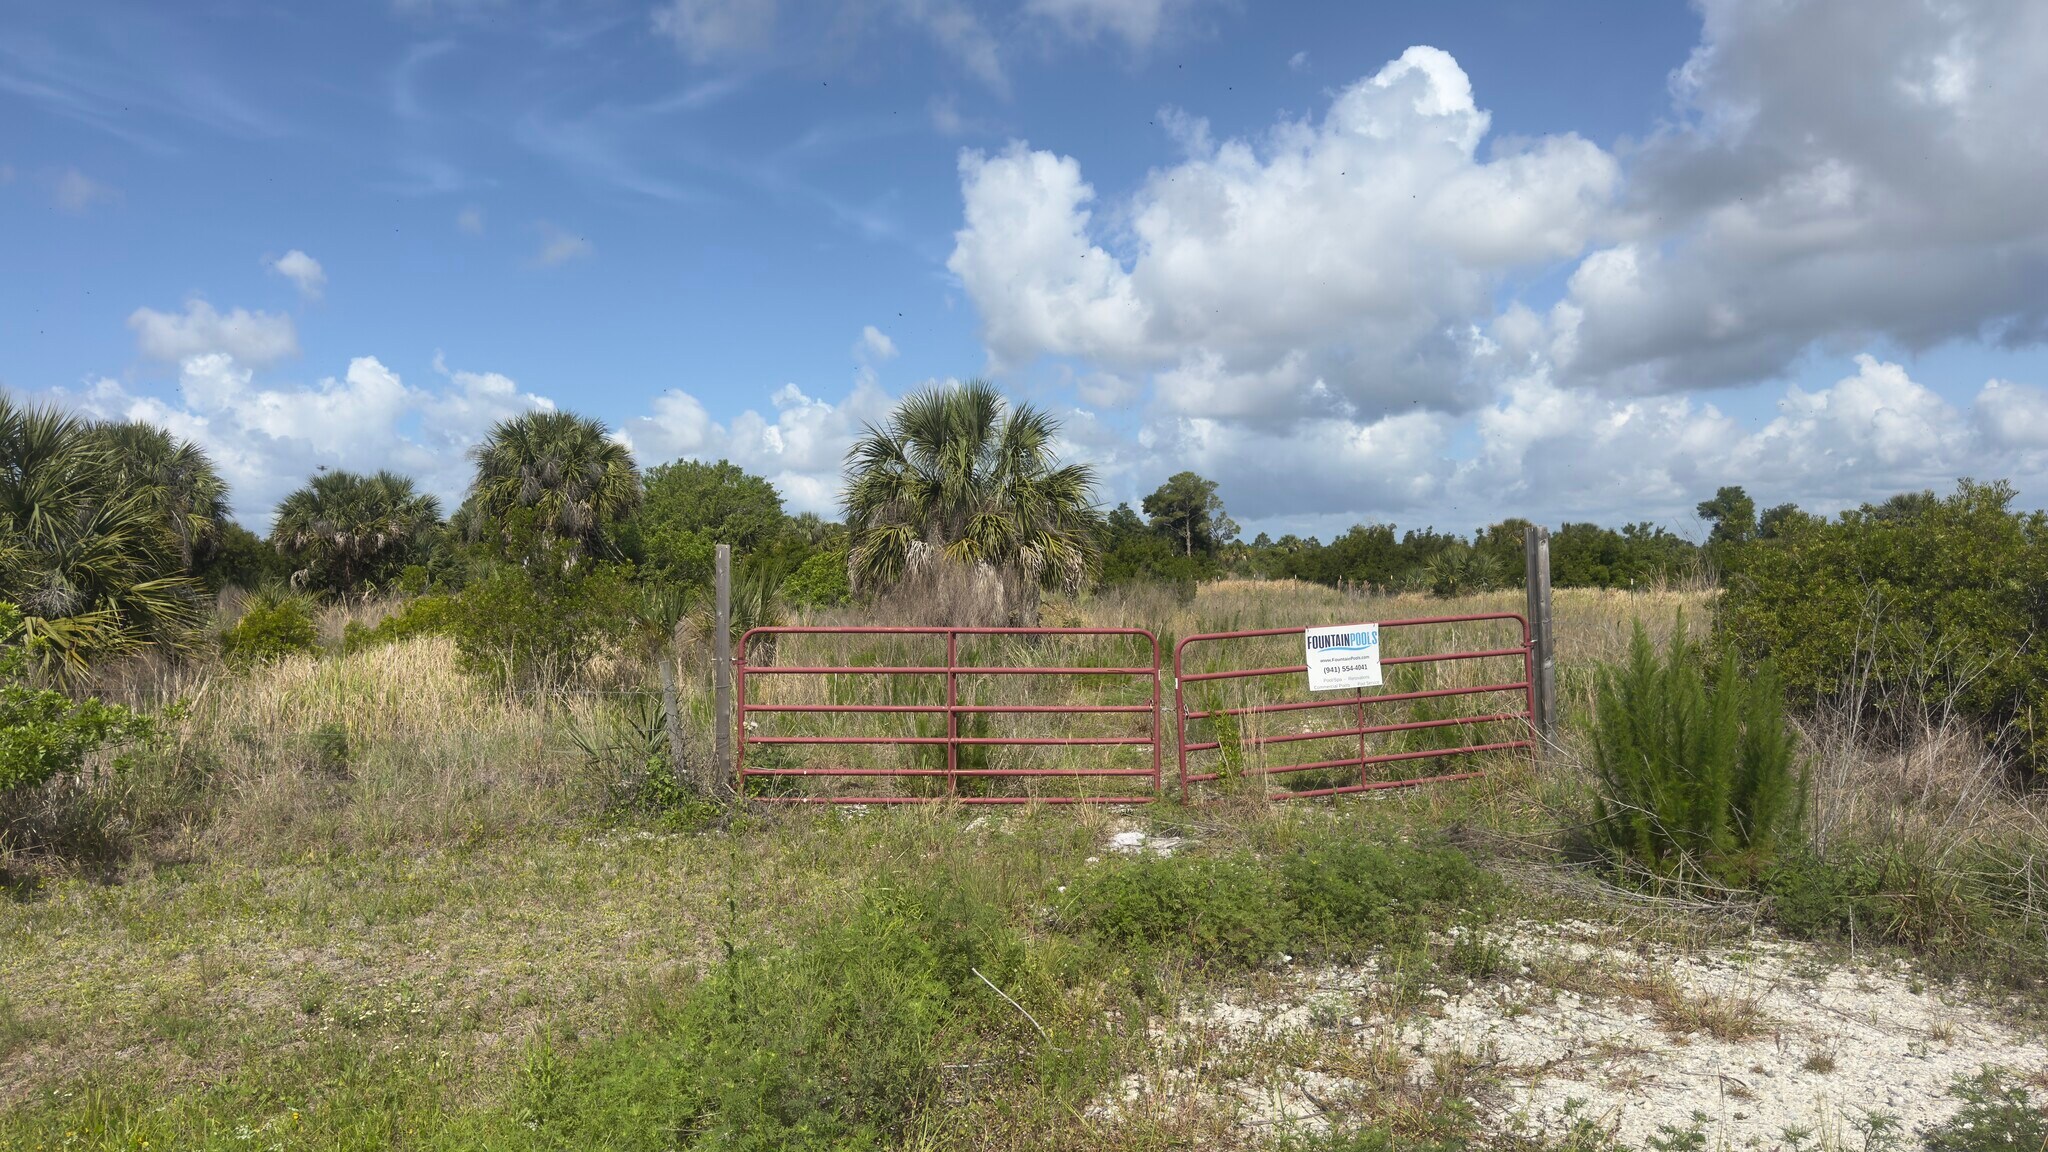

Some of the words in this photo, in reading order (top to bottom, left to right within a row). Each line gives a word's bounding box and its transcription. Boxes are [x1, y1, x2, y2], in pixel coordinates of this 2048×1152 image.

[1307, 630, 1378, 650] FOUNTAINPOOLS
[1320, 655, 1370, 663] www.FountainPools.com
[1323, 666, 1341, 675] (941)
